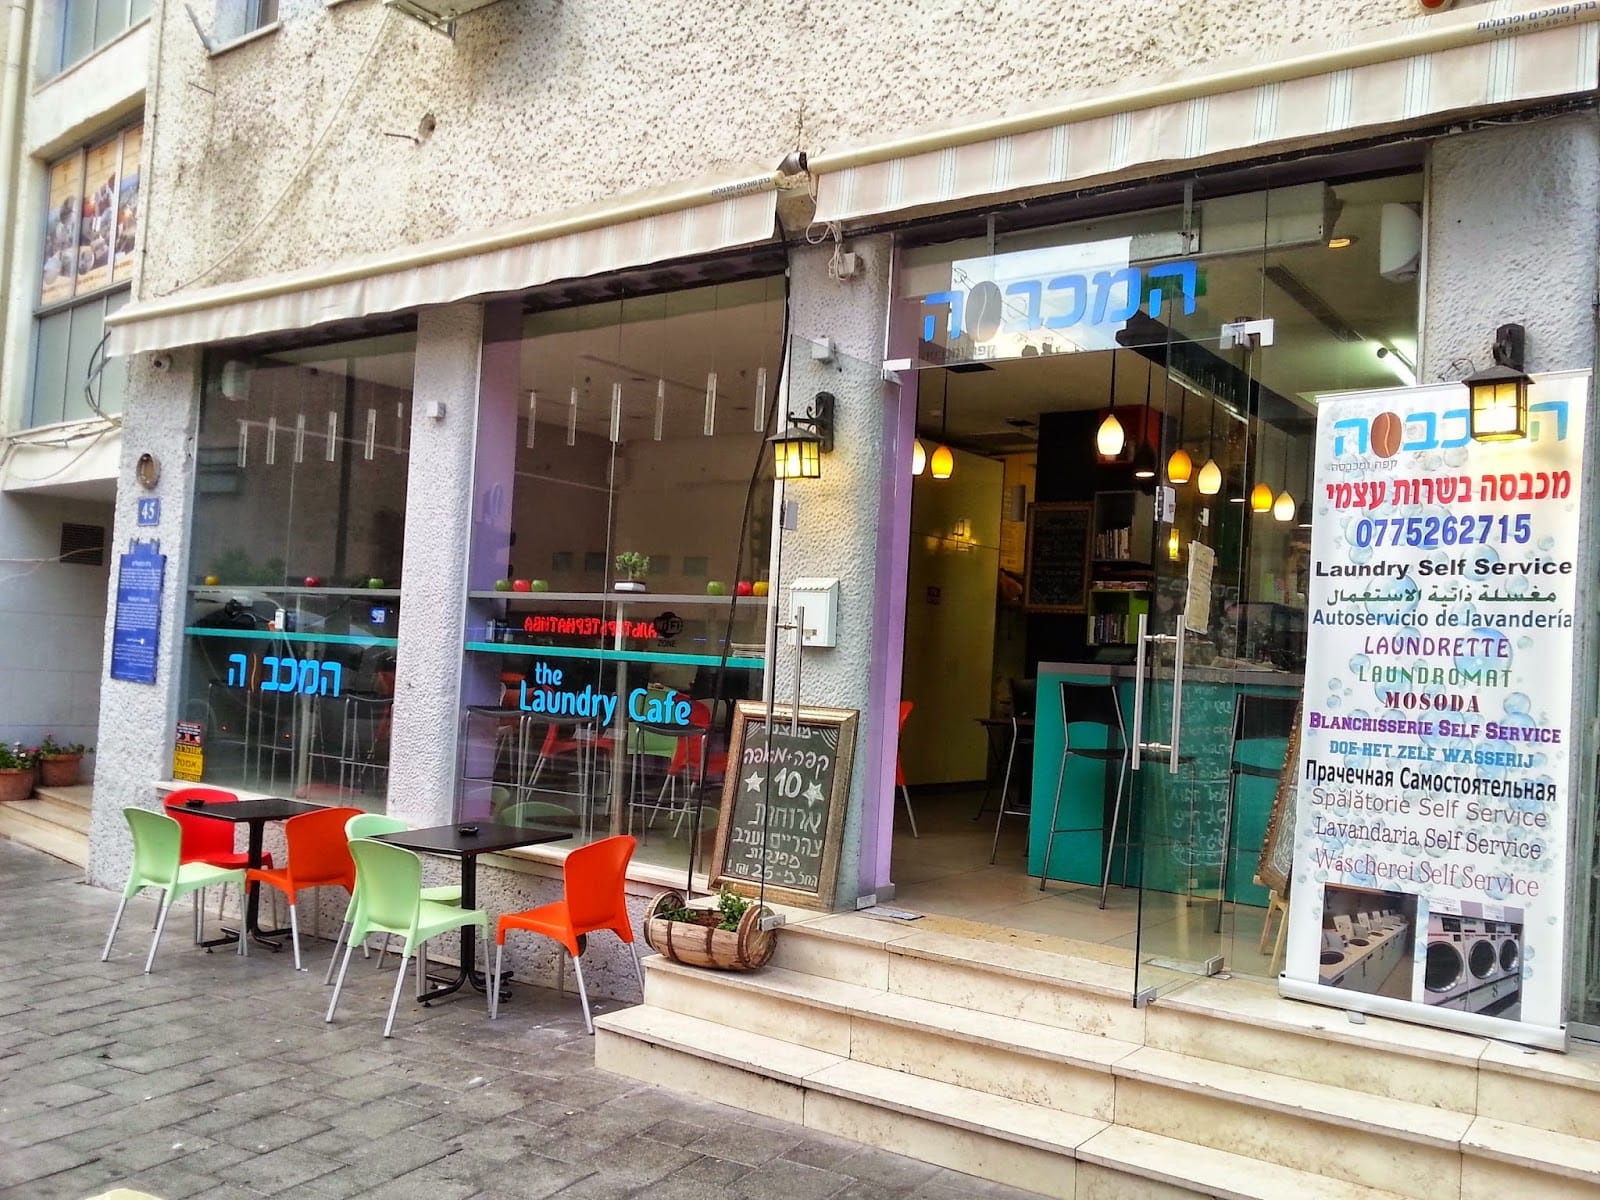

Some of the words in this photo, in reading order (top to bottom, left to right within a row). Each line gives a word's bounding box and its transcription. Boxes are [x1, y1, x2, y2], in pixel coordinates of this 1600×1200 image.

[1574, 1, 1597, 15] ברק
[1331, 462, 1370, 472] ומכבסה
[1375, 460, 1398, 471] קפה
[1326, 480, 1386, 510] עצמי
[1392, 475, 1472, 506] בשרות
[1480, 471, 1571, 502] מכבסה
[141, 501, 155, 520] 45
[1356, 514, 1531, 547] 0775262715
[1315, 561, 1410, 580] Laundry
[1418, 559, 1467, 576] Self
[1474, 558, 1572, 576] Service
[1327, 588, 1422, 606] الاستعمال
[1428, 585, 1473, 607] ذاتية
[1478, 584, 1557, 602] مغسلة
[1312, 608, 1429, 628] Autoservicio
[1435, 609, 1459, 627] de
[1465, 608, 1572, 628] lavandería
[1364, 636, 1510, 658] LAUNDRETTE
[535, 662, 563, 686] the
[1359, 665, 1513, 688] LAUNDROMAT
[520, 679, 618, 727] Laundry
[628, 688, 692, 726] Cafe
[1384, 691, 1481, 713] MOSODA
[1309, 711, 1433, 736] BLANCHISSERIE
[1438, 719, 1479, 739] SELF
[1485, 722, 1562, 744] SERVICE
[1397, 745, 1437, 761] ZELF
[1443, 748, 1535, 769] WASSERIJ
[774, 767, 802, 798] 10
[1306, 759, 1394, 787] Прачечная
[1399, 767, 1556, 802] Самостоятельная
[1311, 787, 1411, 814] Spălătorie
[1418, 798, 1460, 818] Self
[1466, 803, 1548, 828] Service
[1315, 817, 1419, 847] Lavandaria
[1424, 829, 1463, 850] Self
[1465, 834, 1542, 860] Service
[1314, 848, 1416, 881] Wäscherei
[1420, 860, 1455, 885] Self
[1461, 867, 1540, 897] Service
